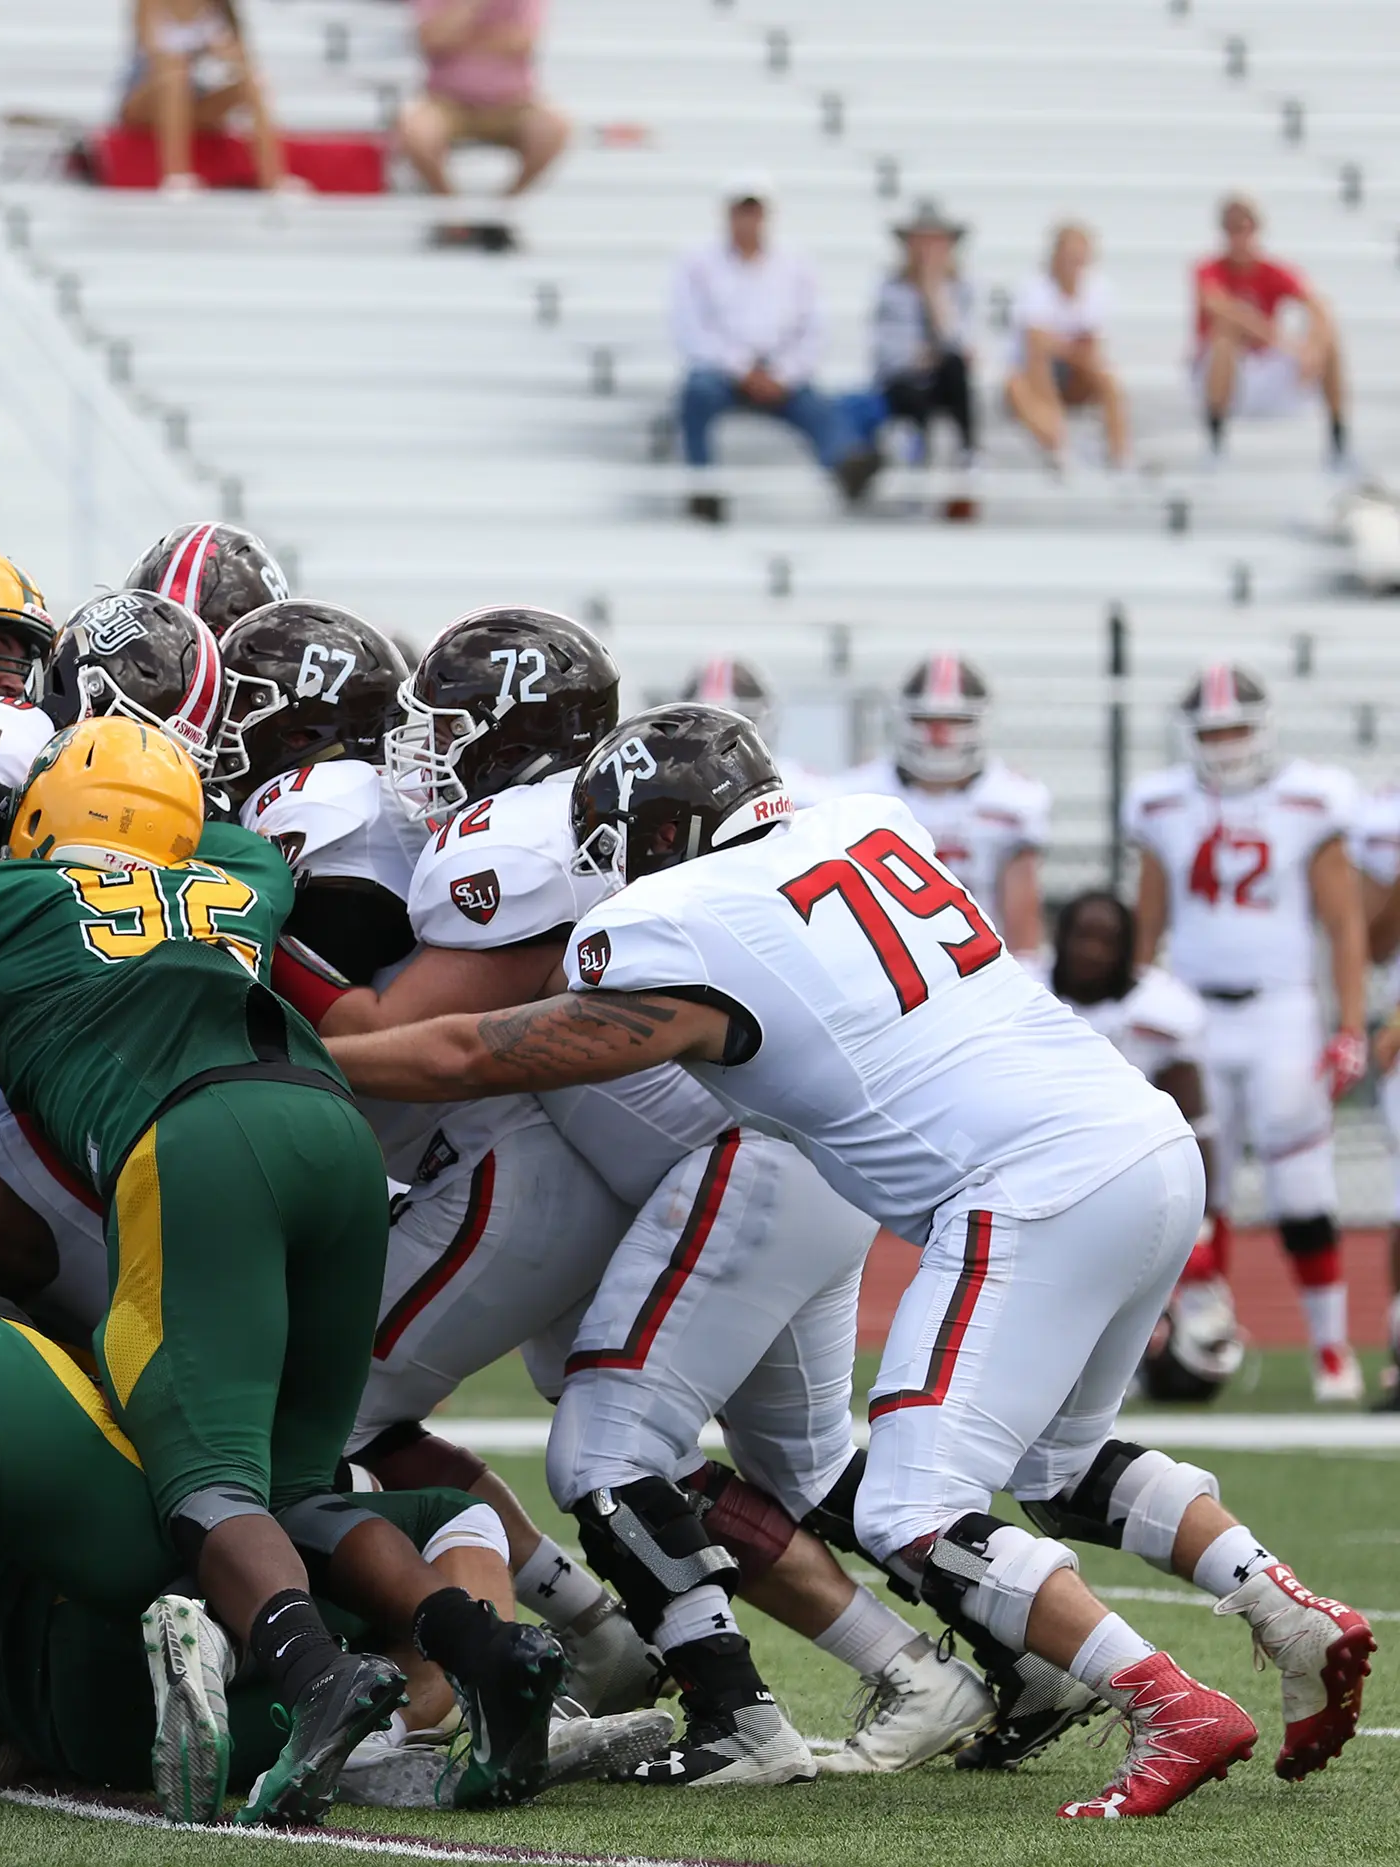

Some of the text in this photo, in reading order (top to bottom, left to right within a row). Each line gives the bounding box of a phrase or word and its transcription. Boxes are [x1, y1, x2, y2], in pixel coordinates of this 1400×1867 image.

[296, 643, 357, 704] 67
[490, 648, 547, 704] 72
[599, 736, 658, 799] 79
[1188, 826, 1272, 909] 42
[56, 859, 262, 982] 92
[778, 829, 1002, 1016] 79
